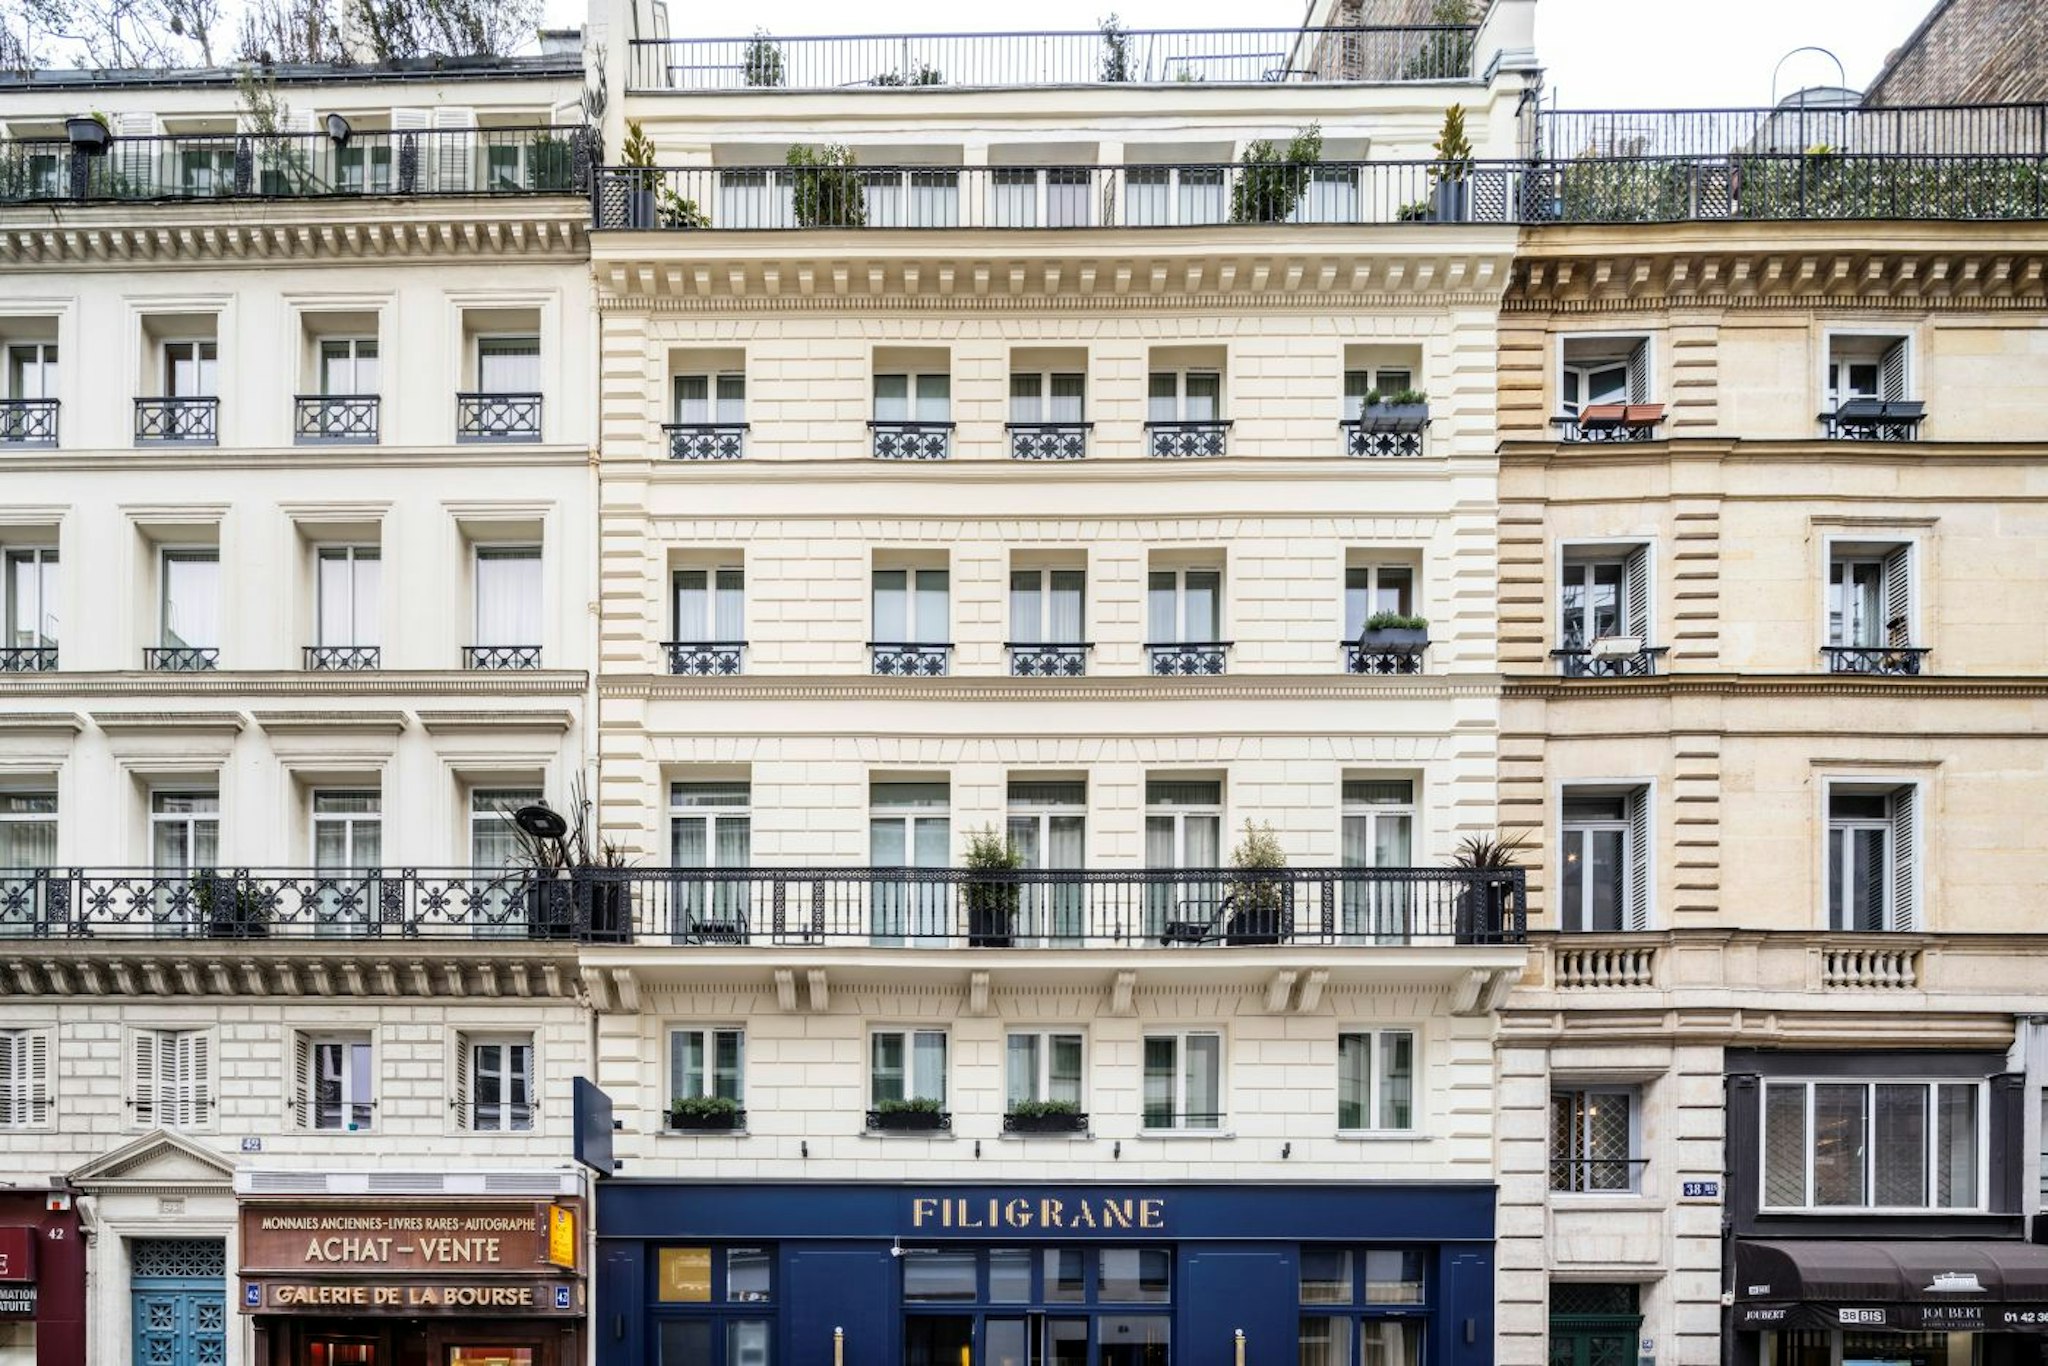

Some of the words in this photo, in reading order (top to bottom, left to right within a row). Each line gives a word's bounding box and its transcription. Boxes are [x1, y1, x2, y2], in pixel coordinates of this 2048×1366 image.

[244, 1139, 259, 1150] 42
[1686, 1184, 1701, 1196] 38
[913, 1199, 1164, 1227] FILIGRANE
[262, 1217, 318, 1230] MONNAIES
[48, 1228, 64, 1240] 42
[305, 1237, 392, 1262] ACHAT
[419, 1238, 500, 1262] VENTE
[276, 1286, 368, 1304] GALERIE
[374, 1287, 402, 1304] DE
[409, 1287, 438, 1304] LA
[443, 1287, 533, 1305] BOURSE
[1745, 1310, 1786, 1320] JOUBERT
[1841, 1311, 1857, 1321] 38
[1860, 1311, 1882, 1322] BIS
[1921, 1307, 1983, 1319] JOUBERT
[2004, 1312, 2018, 1323] 01
[2020, 1312, 2036, 1323] 42
